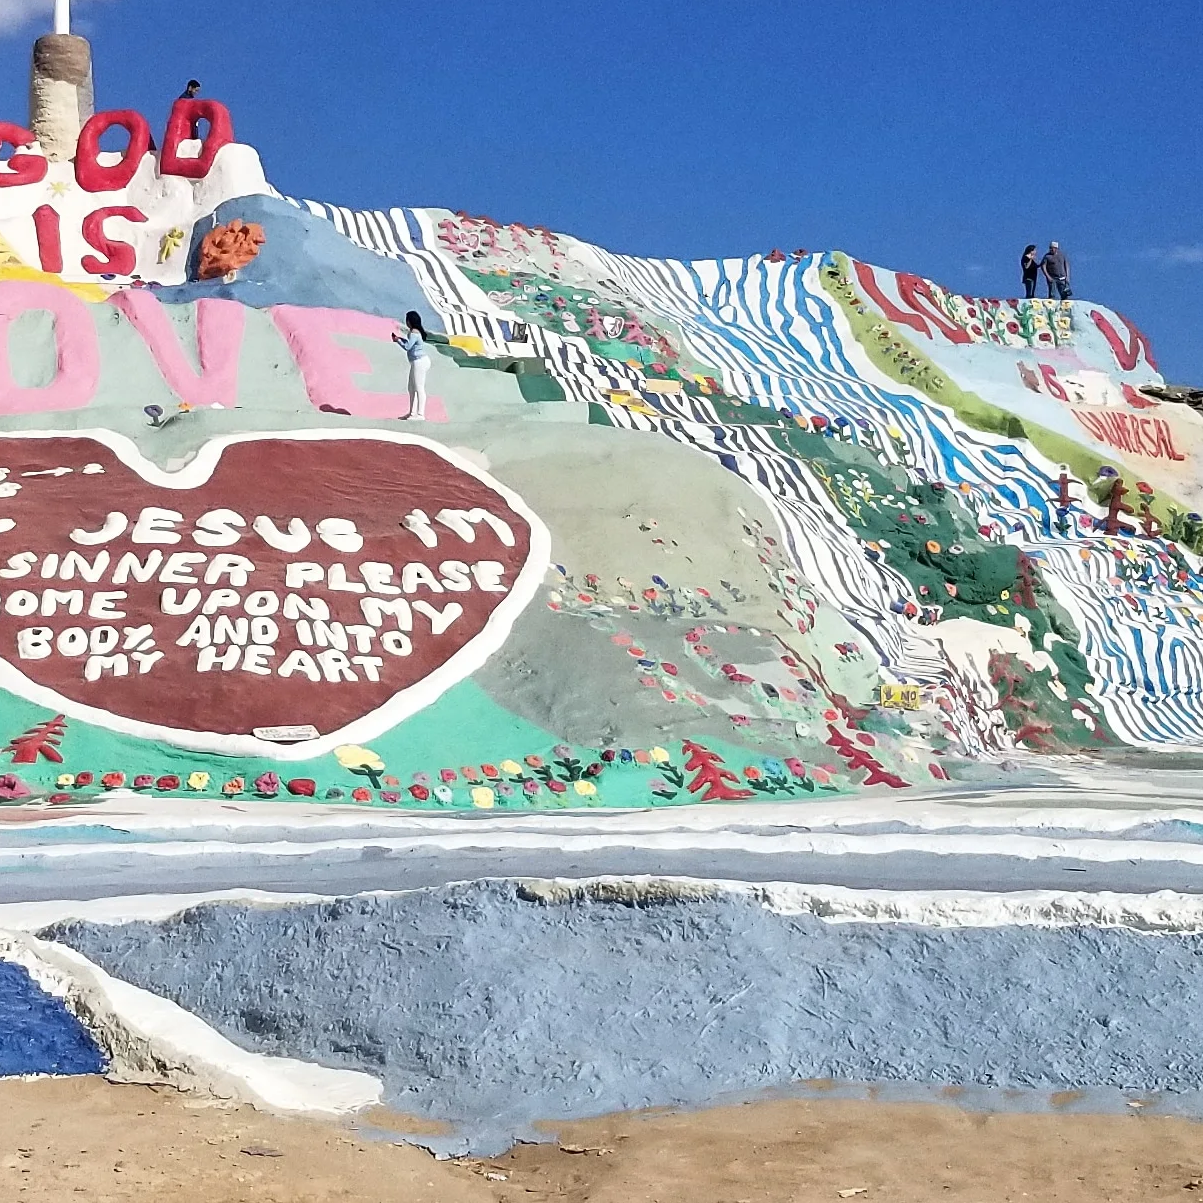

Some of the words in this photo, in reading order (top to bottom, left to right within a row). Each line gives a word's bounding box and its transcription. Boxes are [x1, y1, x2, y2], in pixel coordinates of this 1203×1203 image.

[32, 204, 148, 276] IS
[69, 506, 364, 553] JESUS
[285, 560, 509, 594] PLEASE
[160, 587, 330, 620] UPON
[360, 597, 464, 635] MY
[17, 624, 156, 659] BODY
[175, 615, 279, 648] AND
[295, 620, 413, 656] INTO
[84, 650, 165, 682] MY
[196, 643, 383, 682] HEART
[900, 691, 917, 702] NO
